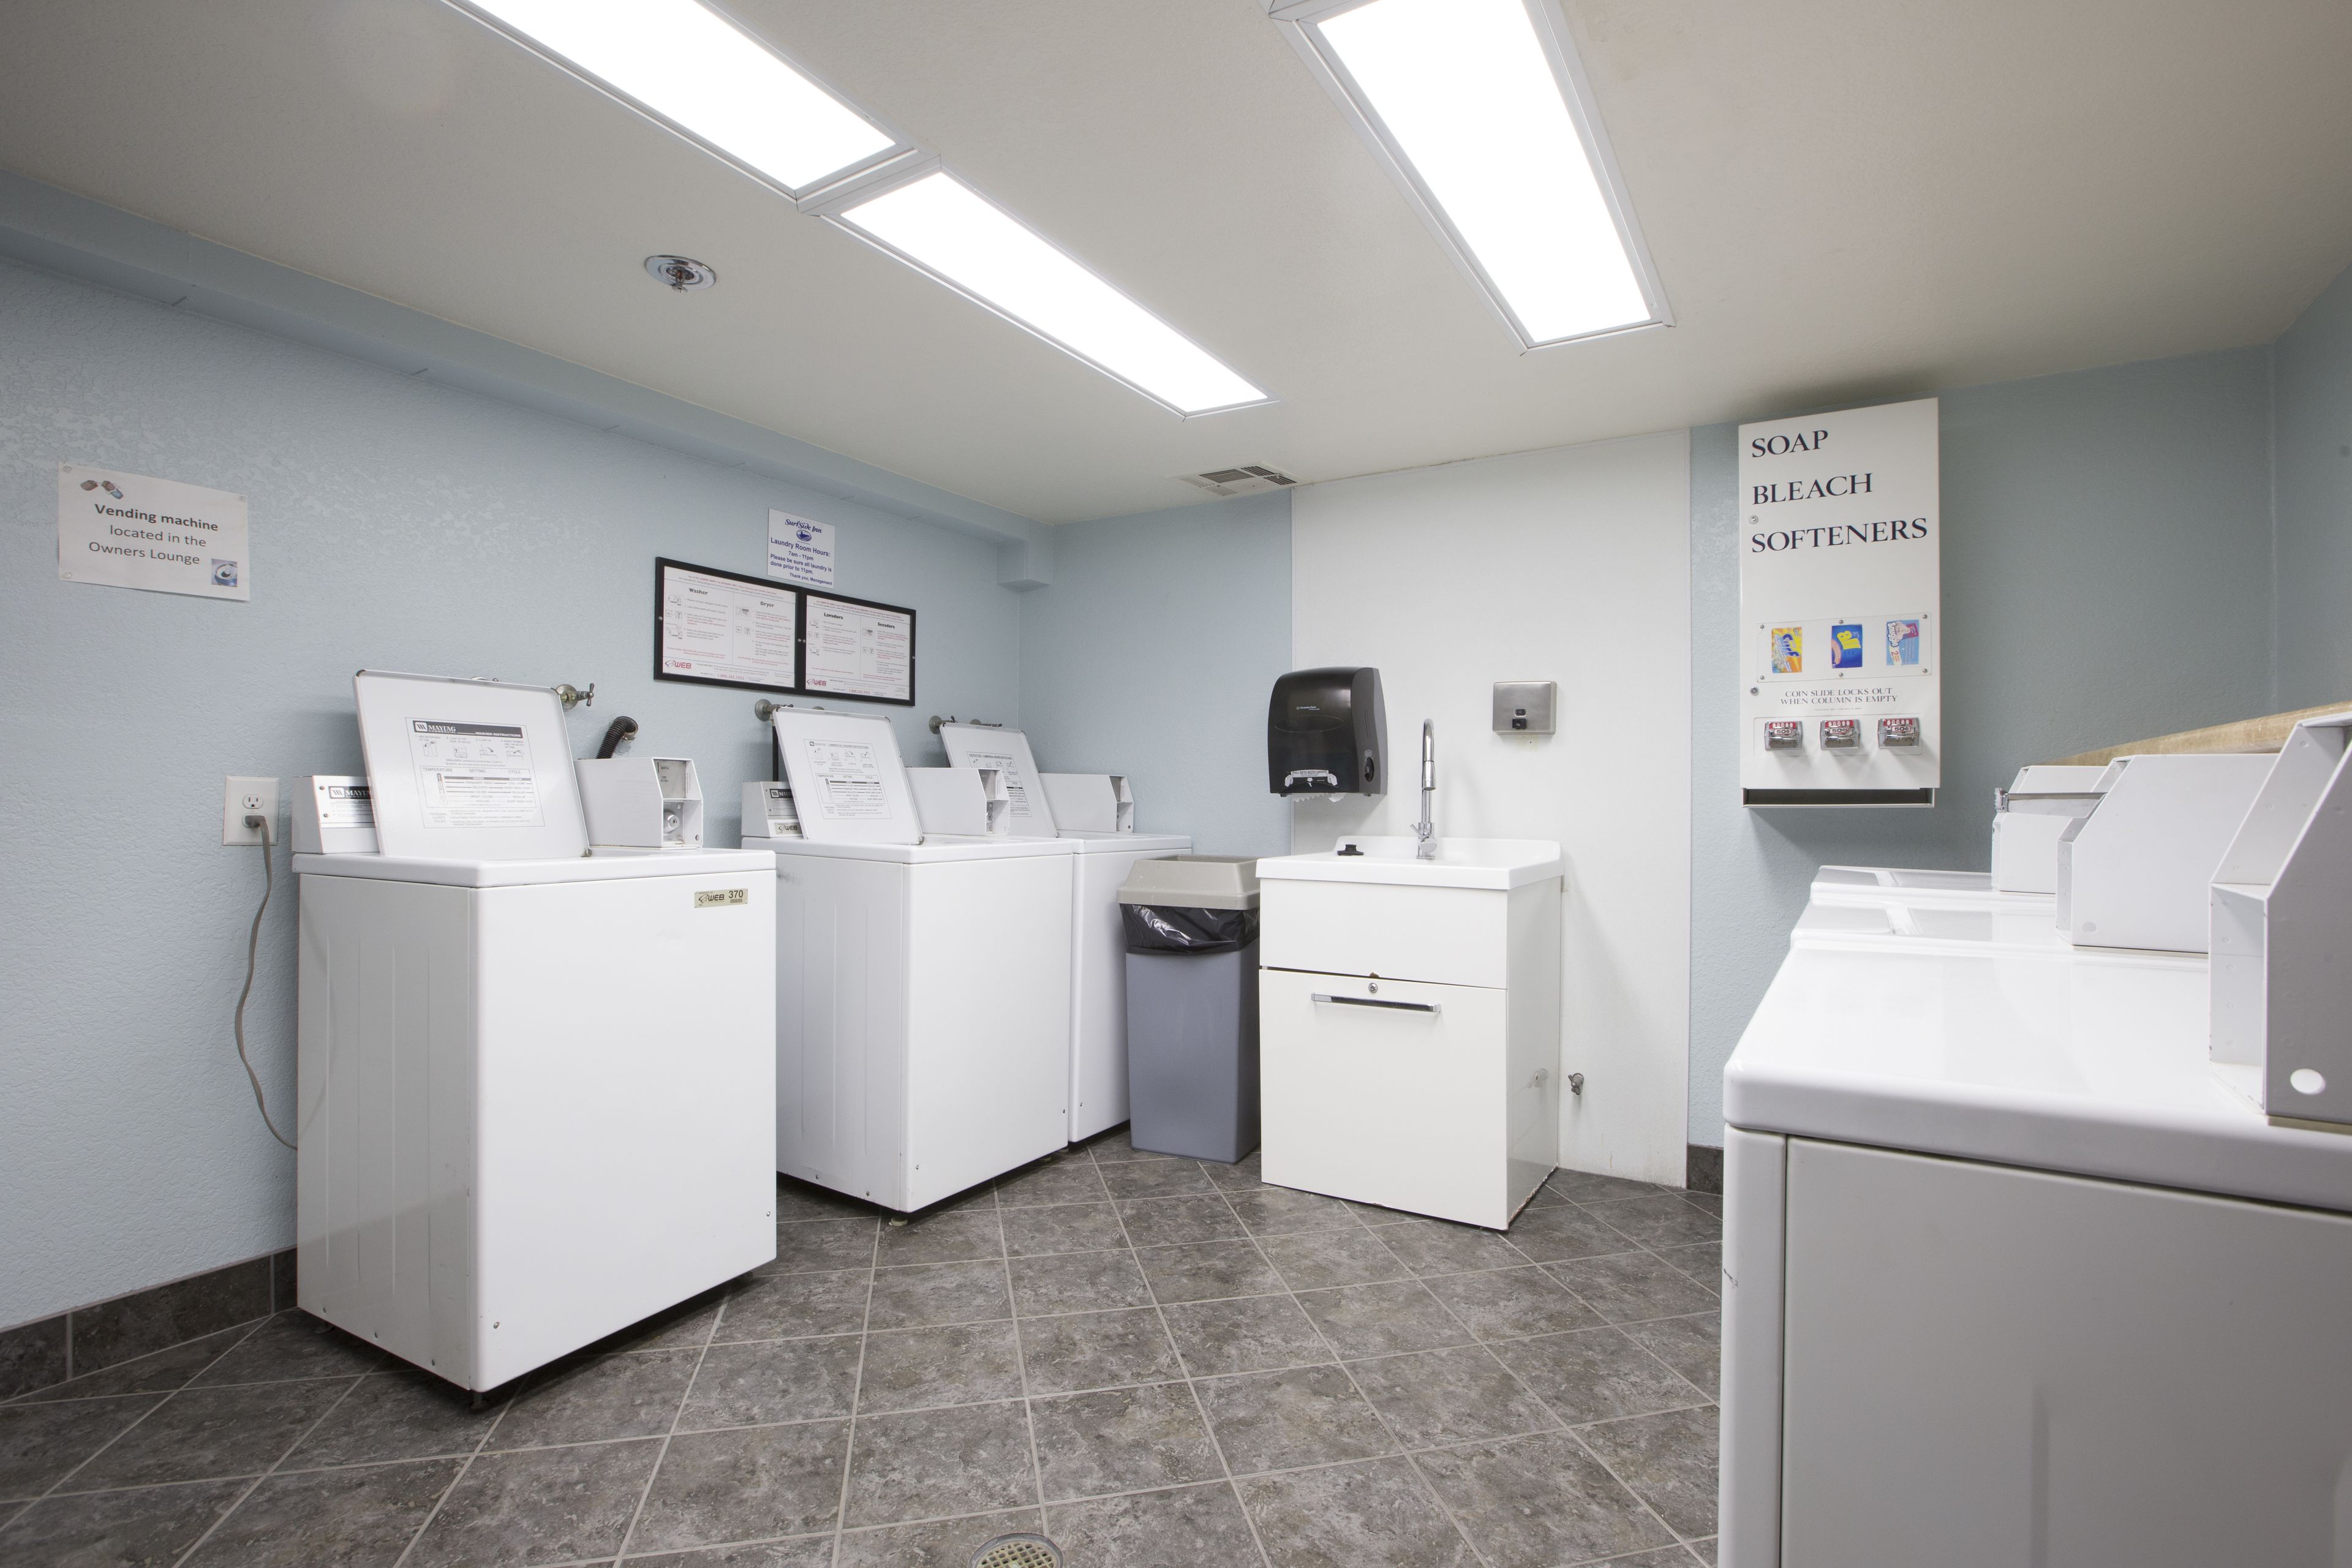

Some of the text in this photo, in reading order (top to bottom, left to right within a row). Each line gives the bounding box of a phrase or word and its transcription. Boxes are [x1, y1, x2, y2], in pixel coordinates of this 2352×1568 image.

[1752, 430, 1828, 458] SOAP
[1752, 473, 1873, 505] BLEACH
[95, 504, 219, 531] Vending machine
[785, 519, 811, 530] SurfSide
[110, 525, 206, 547] located in the
[1752, 518, 1928, 553] SOFTENERS
[89, 542, 200, 565] Owners Lounge
[771, 537, 831, 557] Laundry Room Hours:
[810, 563, 827, 571] laundry
[810, 577, 832, 586] Management
[1887, 622, 1899, 647] Snuggle
[729, 890, 744, 899] 370
